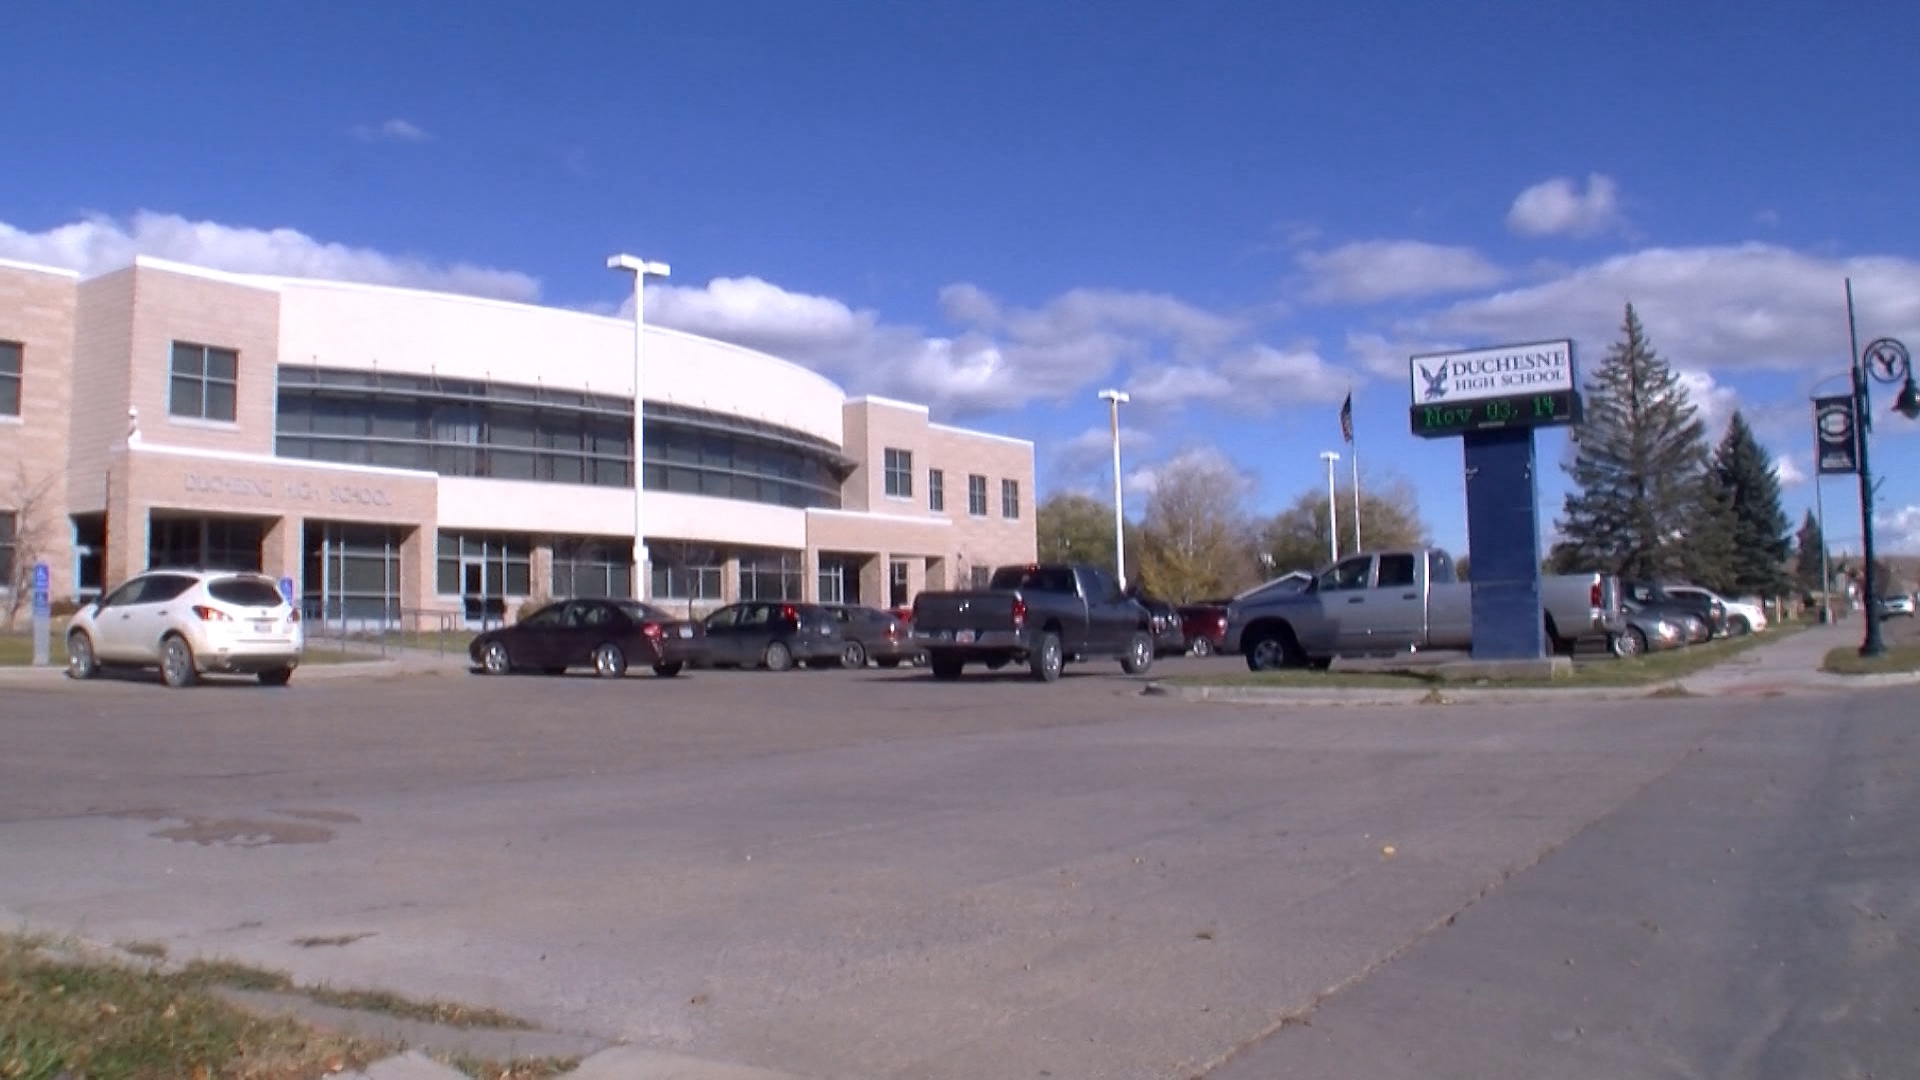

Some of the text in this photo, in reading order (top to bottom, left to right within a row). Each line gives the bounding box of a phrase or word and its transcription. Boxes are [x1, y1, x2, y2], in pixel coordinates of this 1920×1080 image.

[1453, 351, 1566, 376] DUCHESNE
[1455, 369, 1564, 391] HIGH SCHOOL
[1424, 406, 1473, 426] Nov
[1534, 396, 1554, 416] 14
